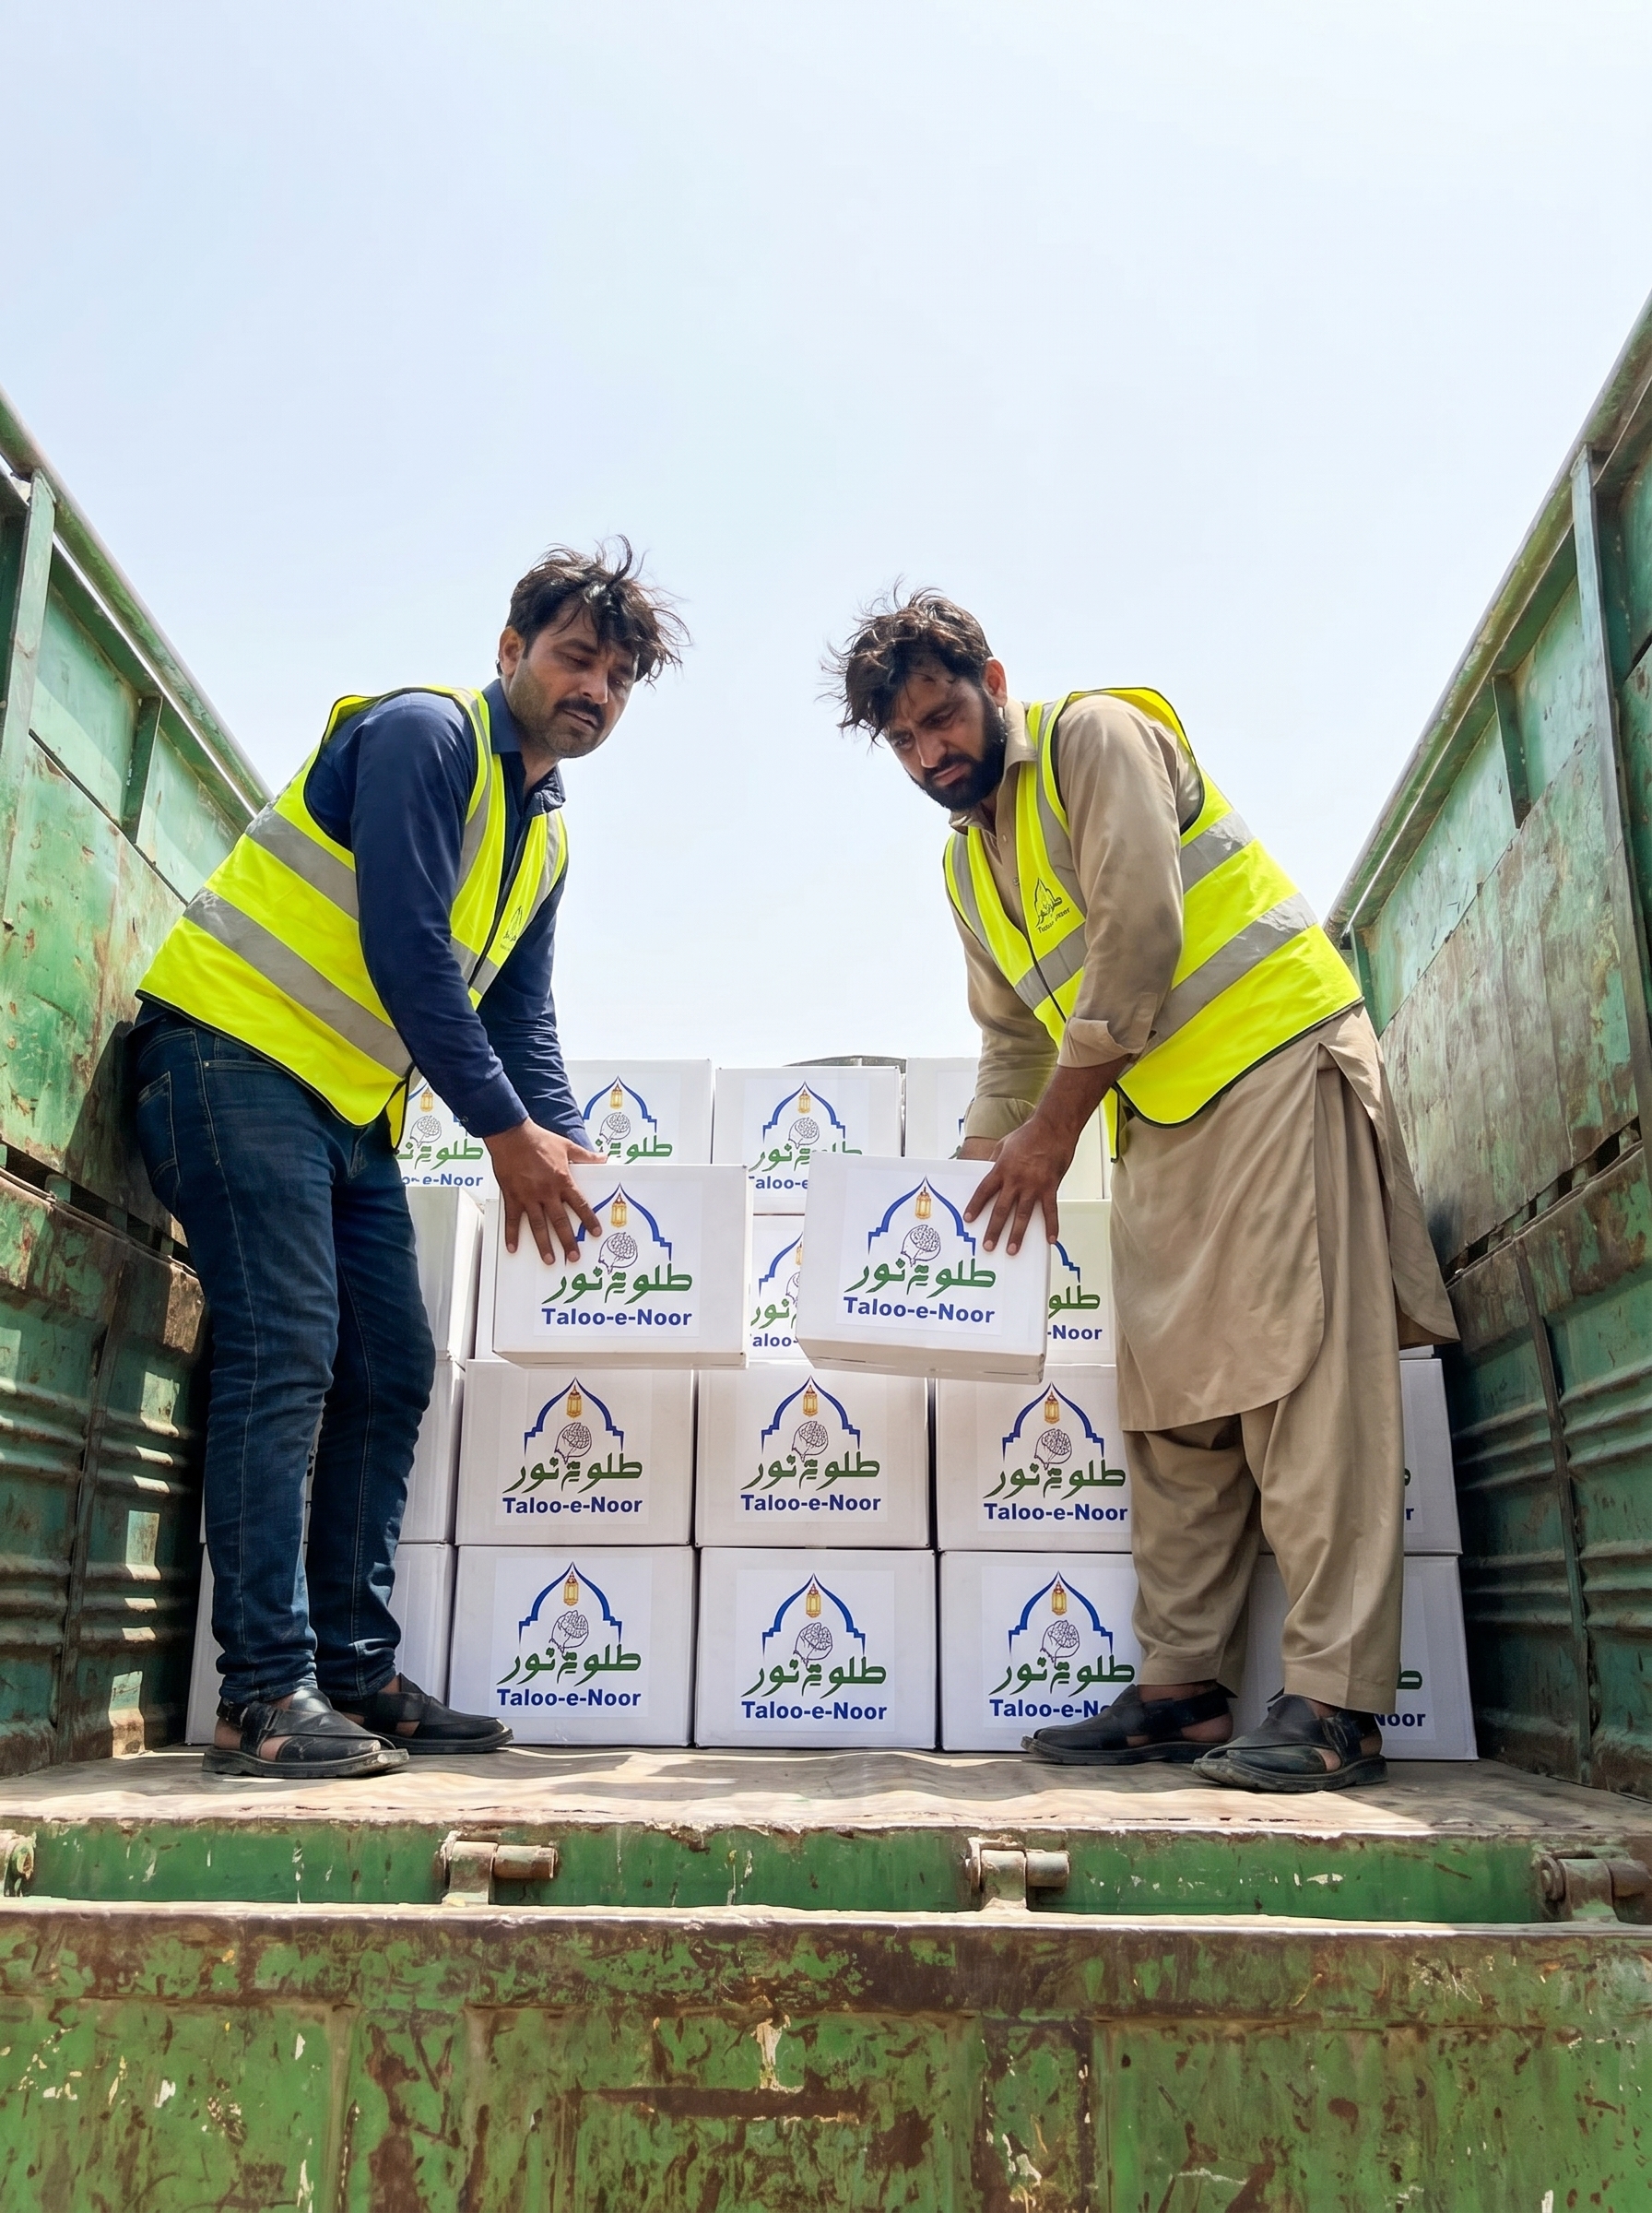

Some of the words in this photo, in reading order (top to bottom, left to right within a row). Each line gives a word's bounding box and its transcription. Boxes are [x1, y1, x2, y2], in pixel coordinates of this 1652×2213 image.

[541, 1308, 692, 1326] Taloo-e-Noor
[843, 1296, 996, 1323] Taloo-e-Noor
[502, 1496, 643, 1514] Taloo-e-Noor
[740, 1494, 881, 1512] Taloo-e-Noor
[984, 1502, 1128, 1522] Taloo-e-Noor
[497, 1687, 642, 1708] Taloo-e-Noor
[741, 1700, 888, 1722] Taloo-e-Noor
[989, 1698, 1112, 1718] Taloo-e-N
